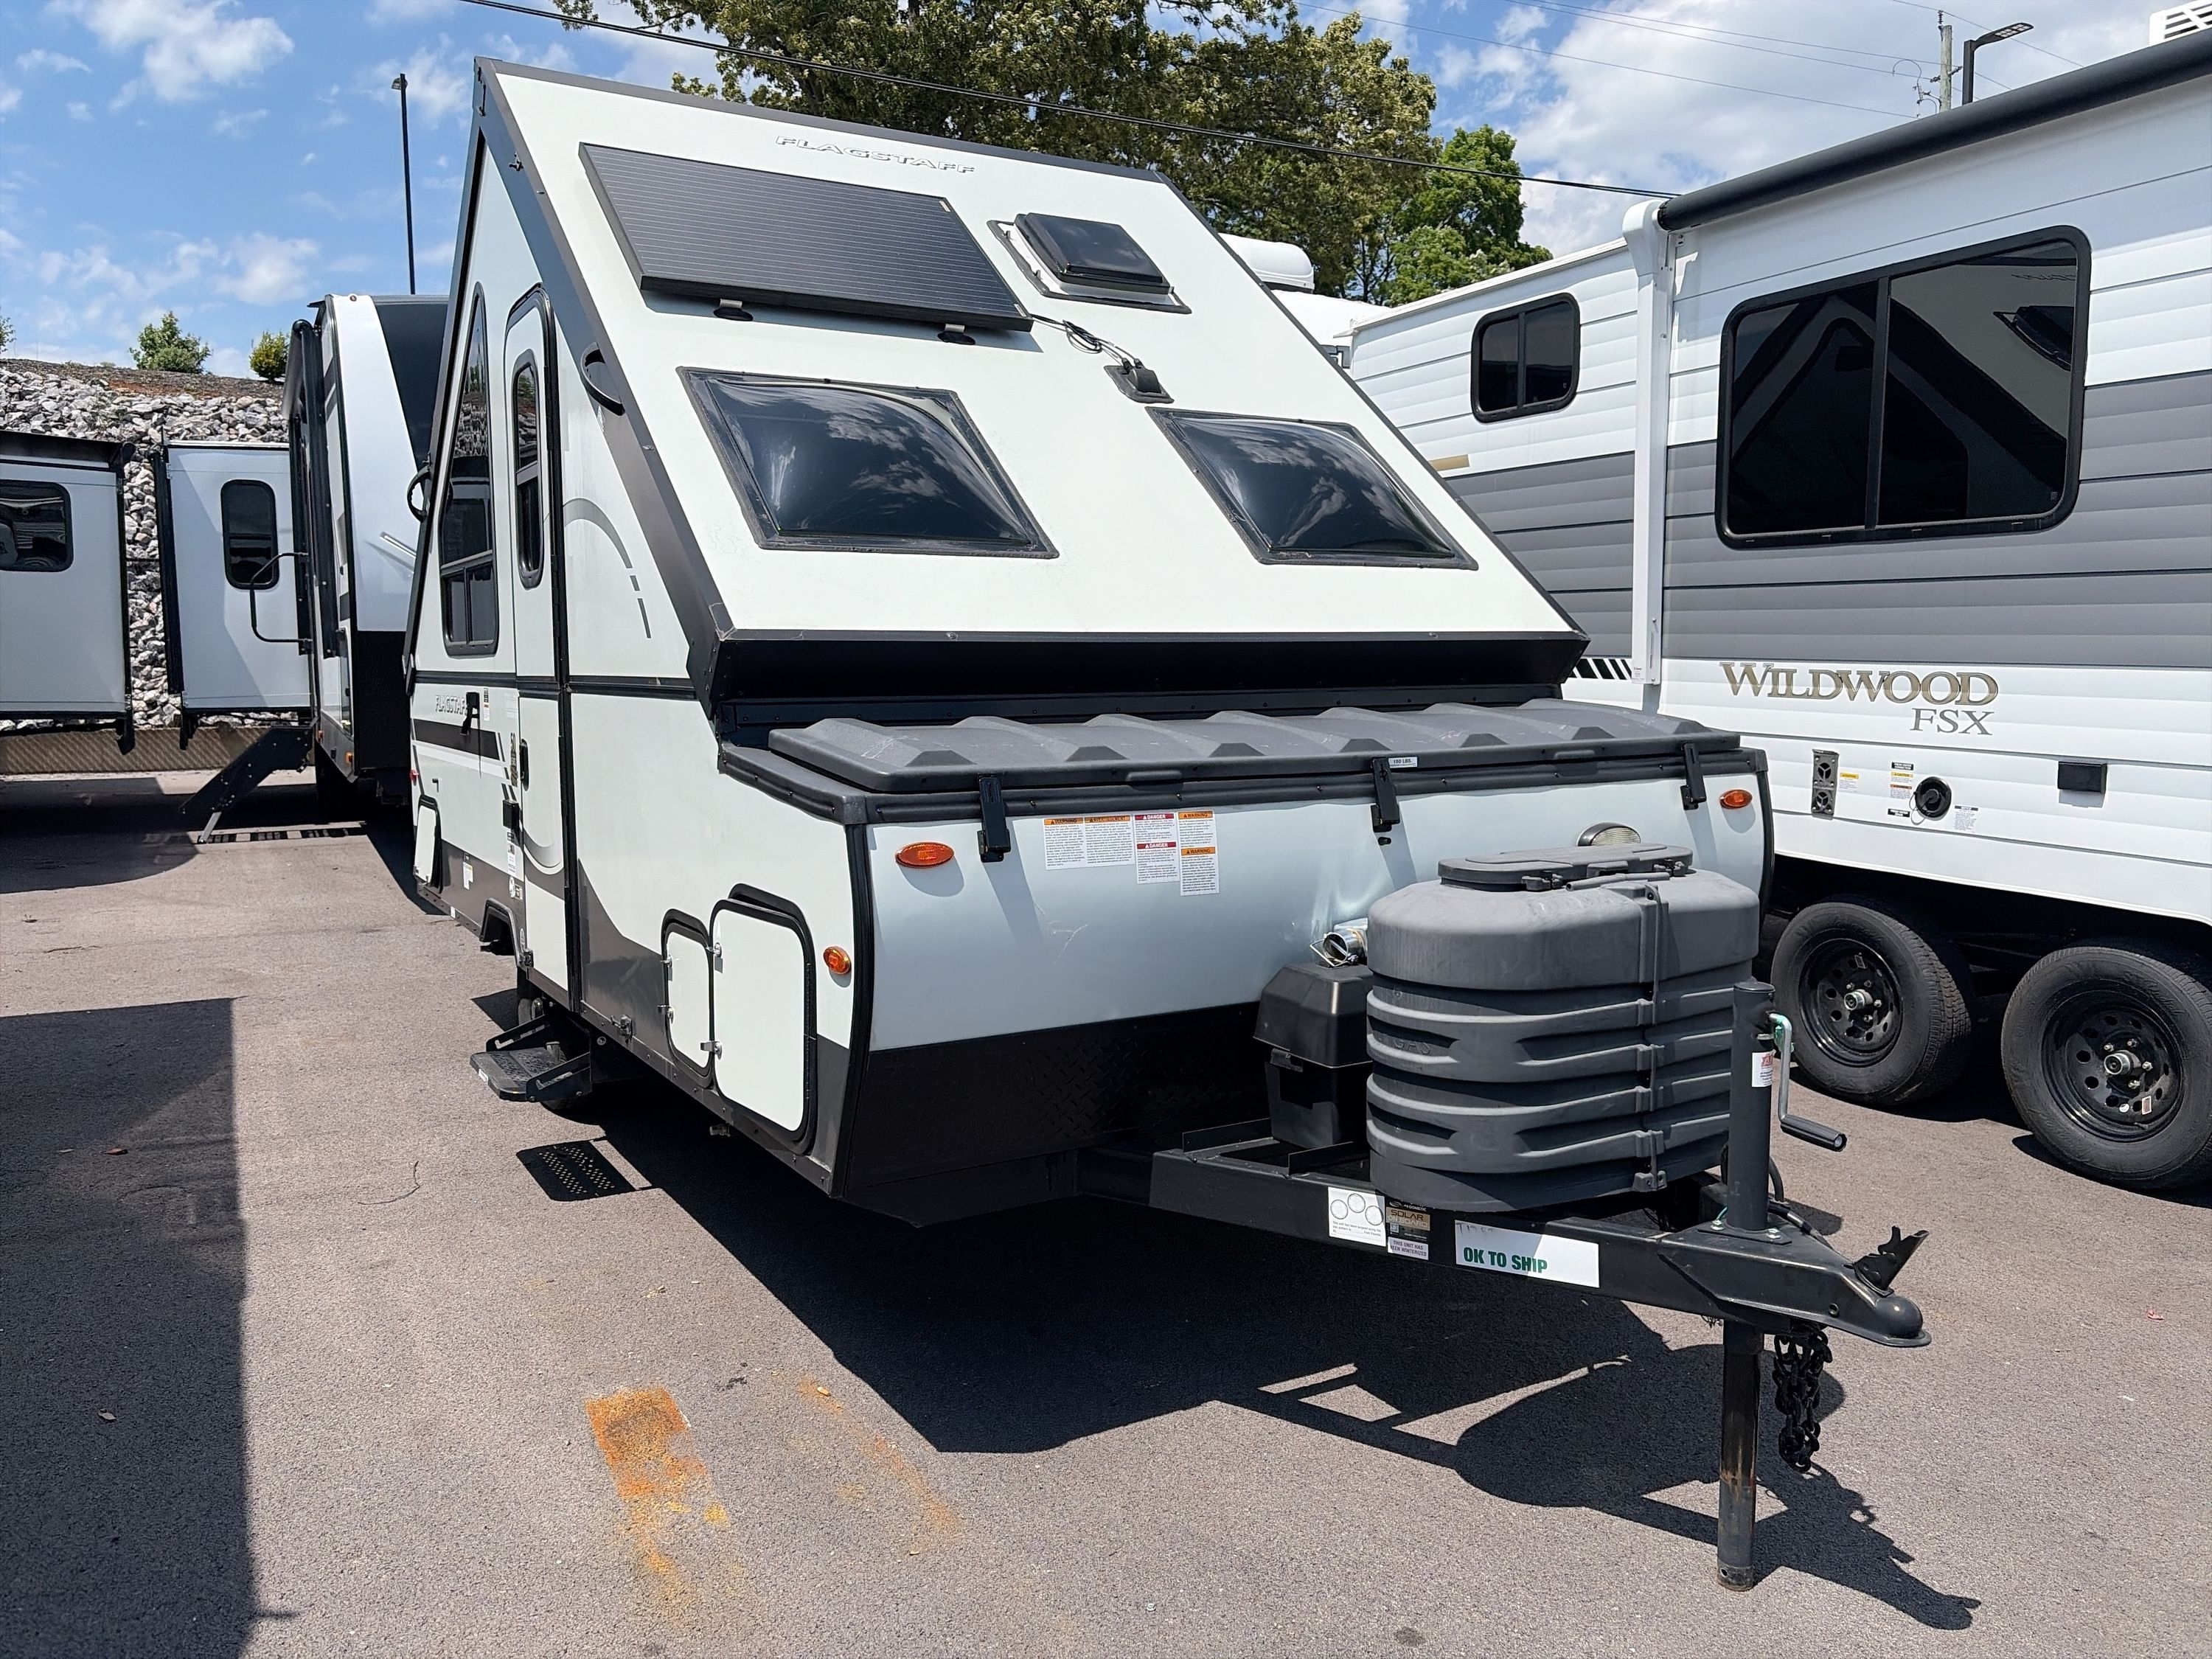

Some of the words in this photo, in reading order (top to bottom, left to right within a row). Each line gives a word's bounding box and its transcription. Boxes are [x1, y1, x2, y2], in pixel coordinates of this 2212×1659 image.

[776, 135, 975, 174] FLAGSTAFF
[1719, 661, 1999, 706] WILDWOOD
[435, 695, 467, 715] FLAGSTAF
[1909, 707, 1994, 736] FSX
[1391, 1209, 1424, 1221] SOLAR
[1399, 1217, 1427, 1228] BOARD
[1402, 1247, 1427, 1256] WINTERIZED
[1464, 1247, 1484, 1265] OK
[1488, 1251, 1506, 1267] TO
[1512, 1255, 1548, 1273] SHIP
